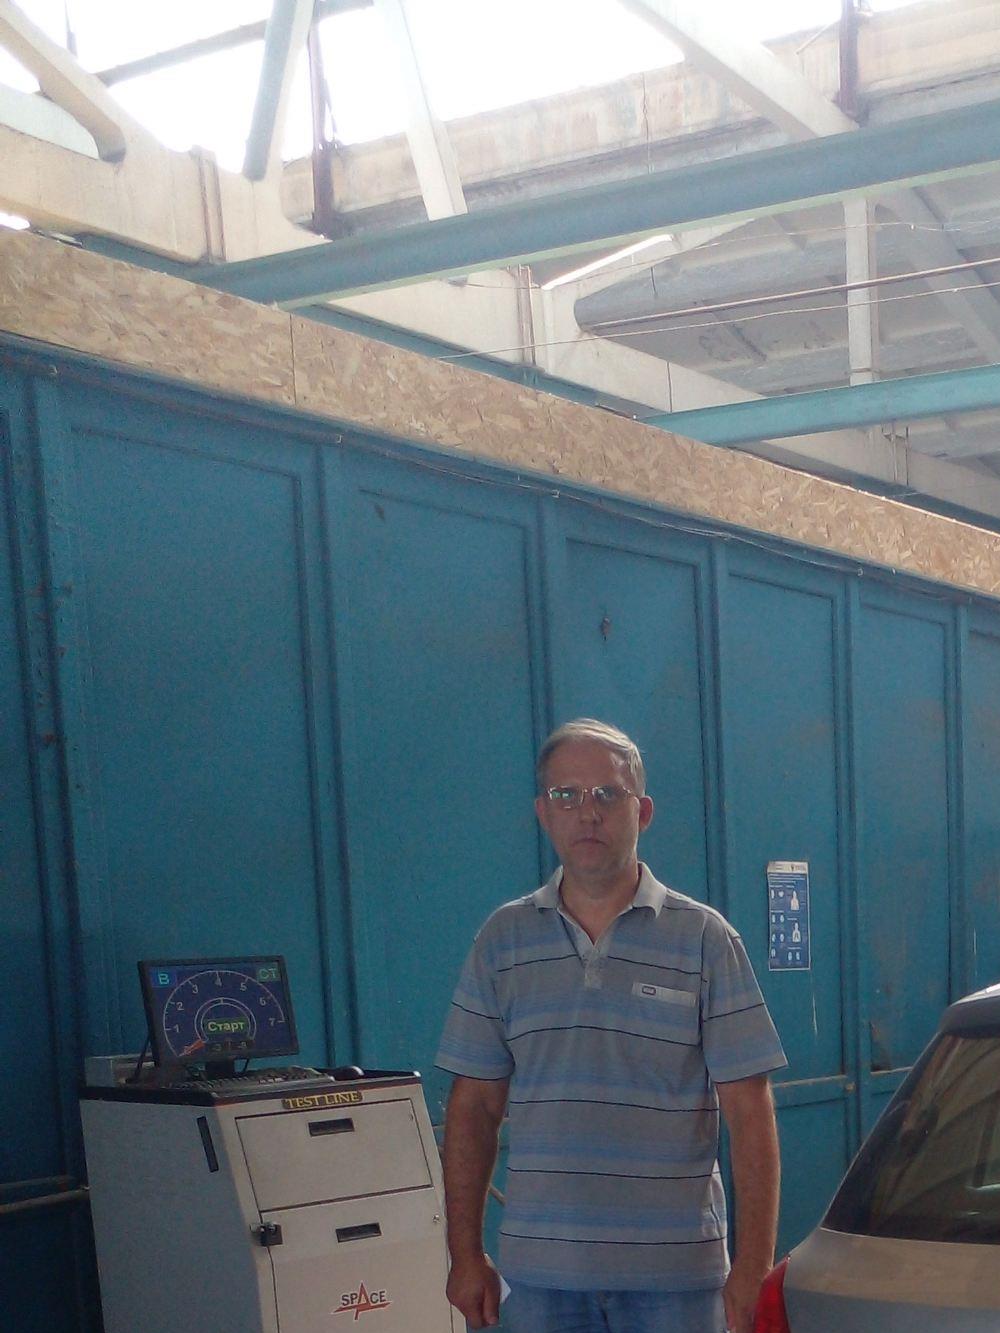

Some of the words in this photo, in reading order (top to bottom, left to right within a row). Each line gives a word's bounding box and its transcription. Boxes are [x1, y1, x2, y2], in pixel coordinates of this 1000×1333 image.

[192, 984, 199, 994] 3
[239, 982, 247, 992] 5
[176, 1001, 184, 1011] 2
[268, 1017, 275, 1026] 7
[173, 1024, 180, 1033] 1
[207, 1021, 245, 1033] Старт
[285, 1095, 320, 1109] TEST
[323, 1091, 359, 1105] LINE
[341, 1283, 387, 1307] SPACE
